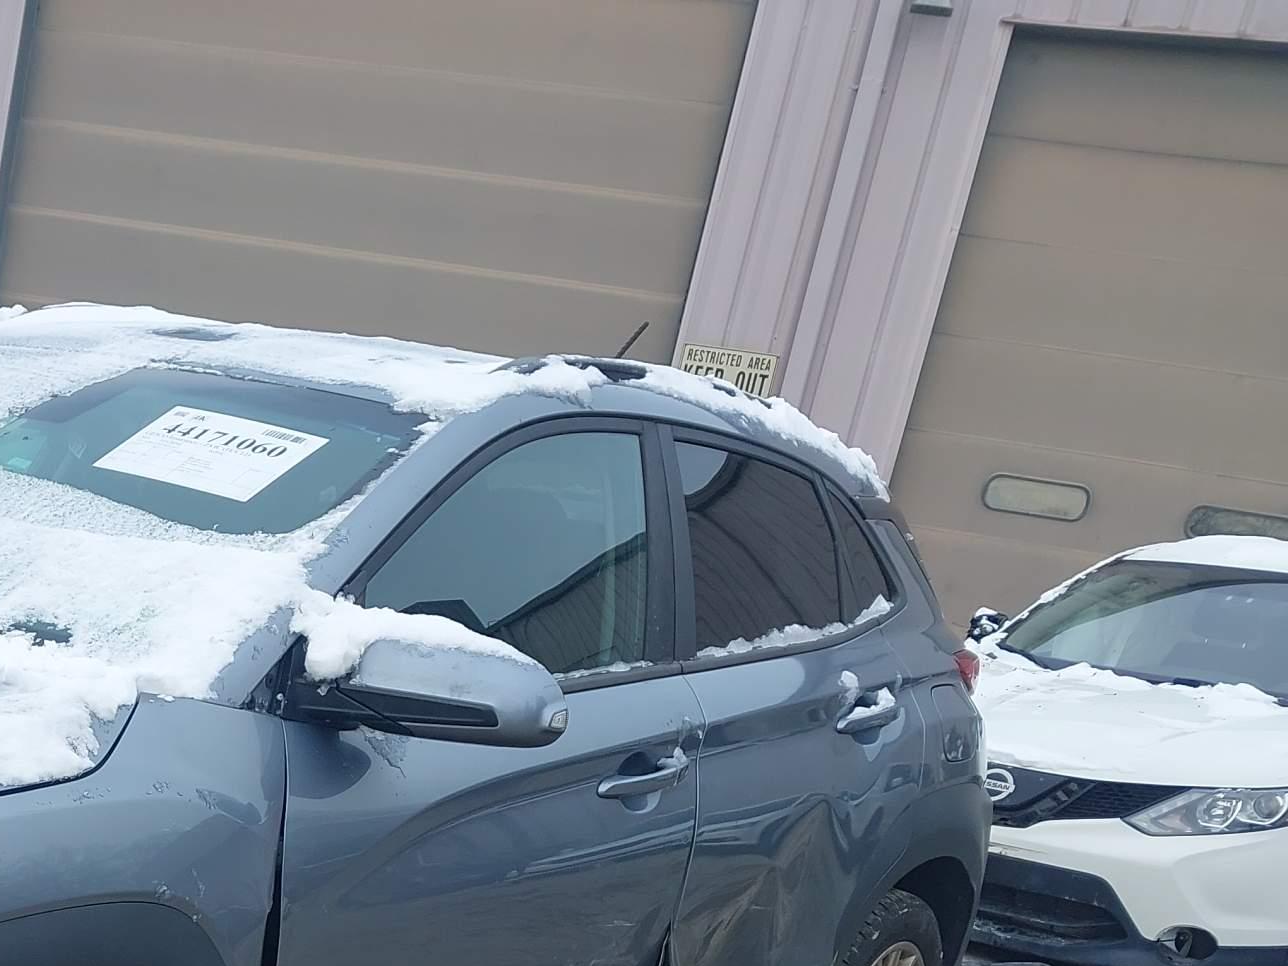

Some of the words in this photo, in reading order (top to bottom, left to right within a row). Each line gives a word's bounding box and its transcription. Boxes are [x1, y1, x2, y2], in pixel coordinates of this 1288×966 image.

[687, 348, 742, 367] RESTRICTED
[747, 357, 771, 371] AREA
[735, 371, 769, 396] OUT
[162, 423, 288, 458] 44171060
[986, 781, 1010, 791] SSAN
